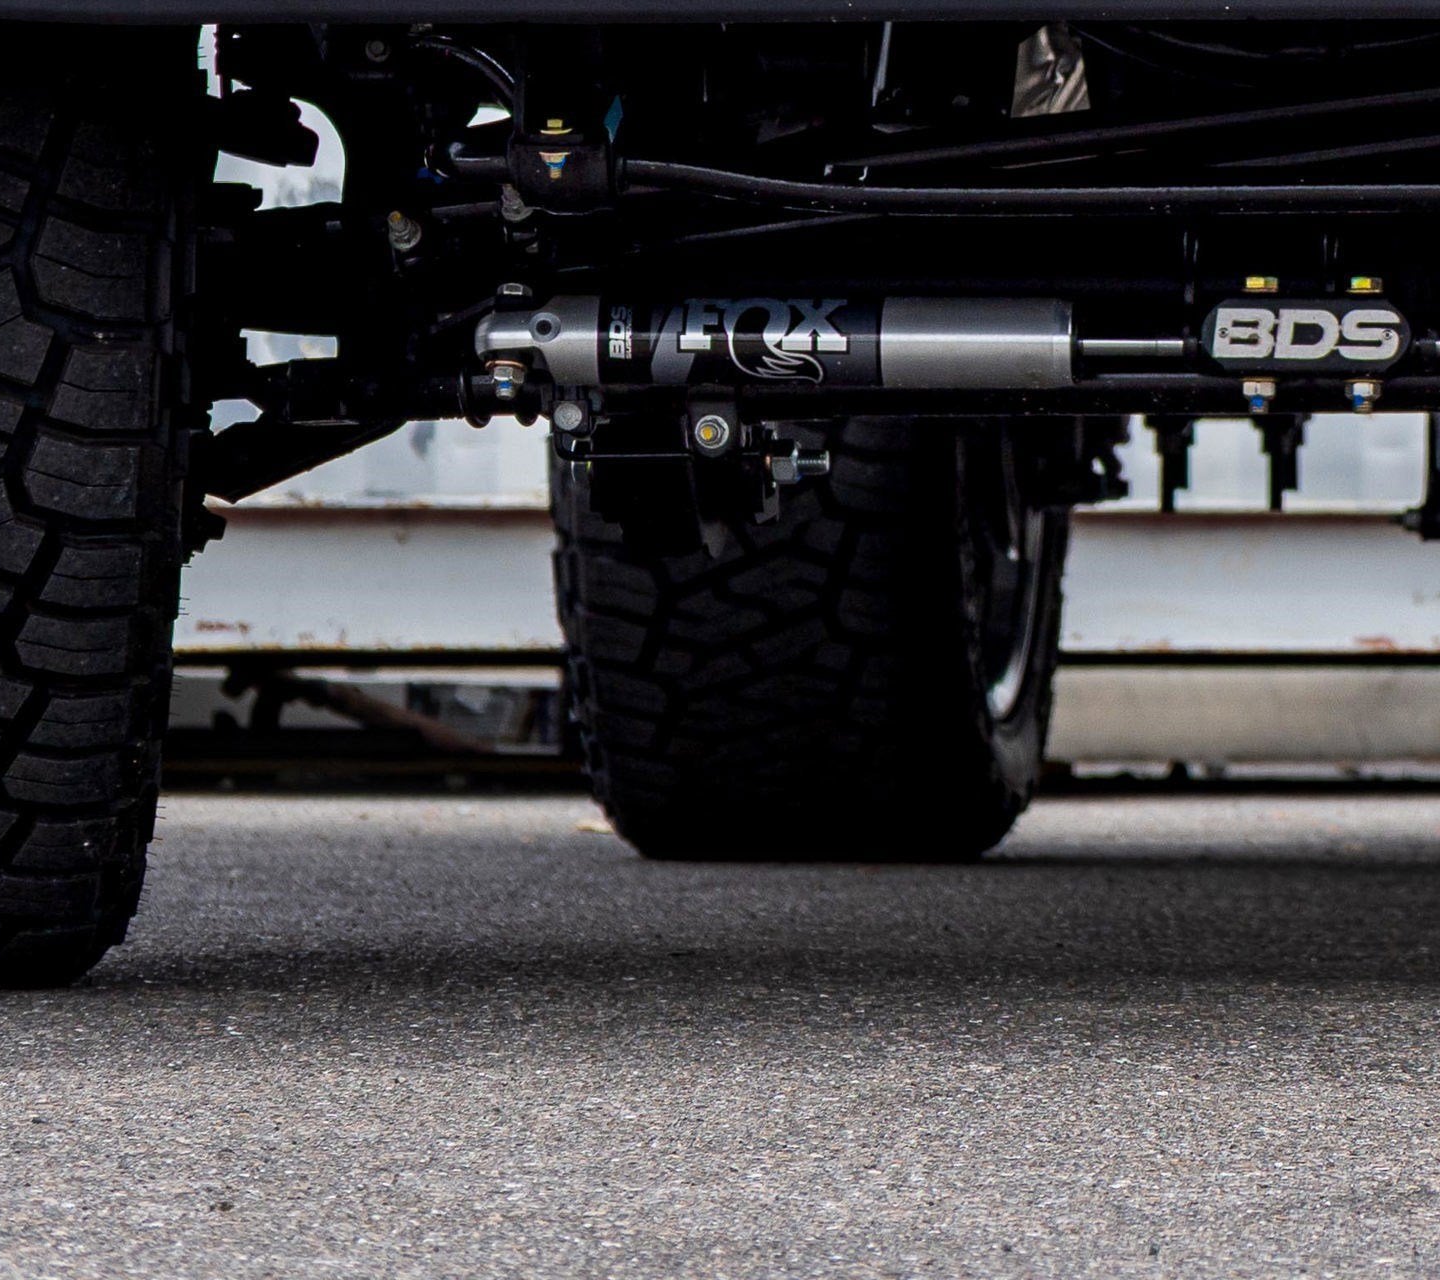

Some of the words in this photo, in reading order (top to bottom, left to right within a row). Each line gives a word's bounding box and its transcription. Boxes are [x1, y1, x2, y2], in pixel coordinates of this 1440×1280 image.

[609, 306, 626, 359] BDS
[680, 298, 848, 383] FOX
[1212, 307, 1401, 360] BDS
